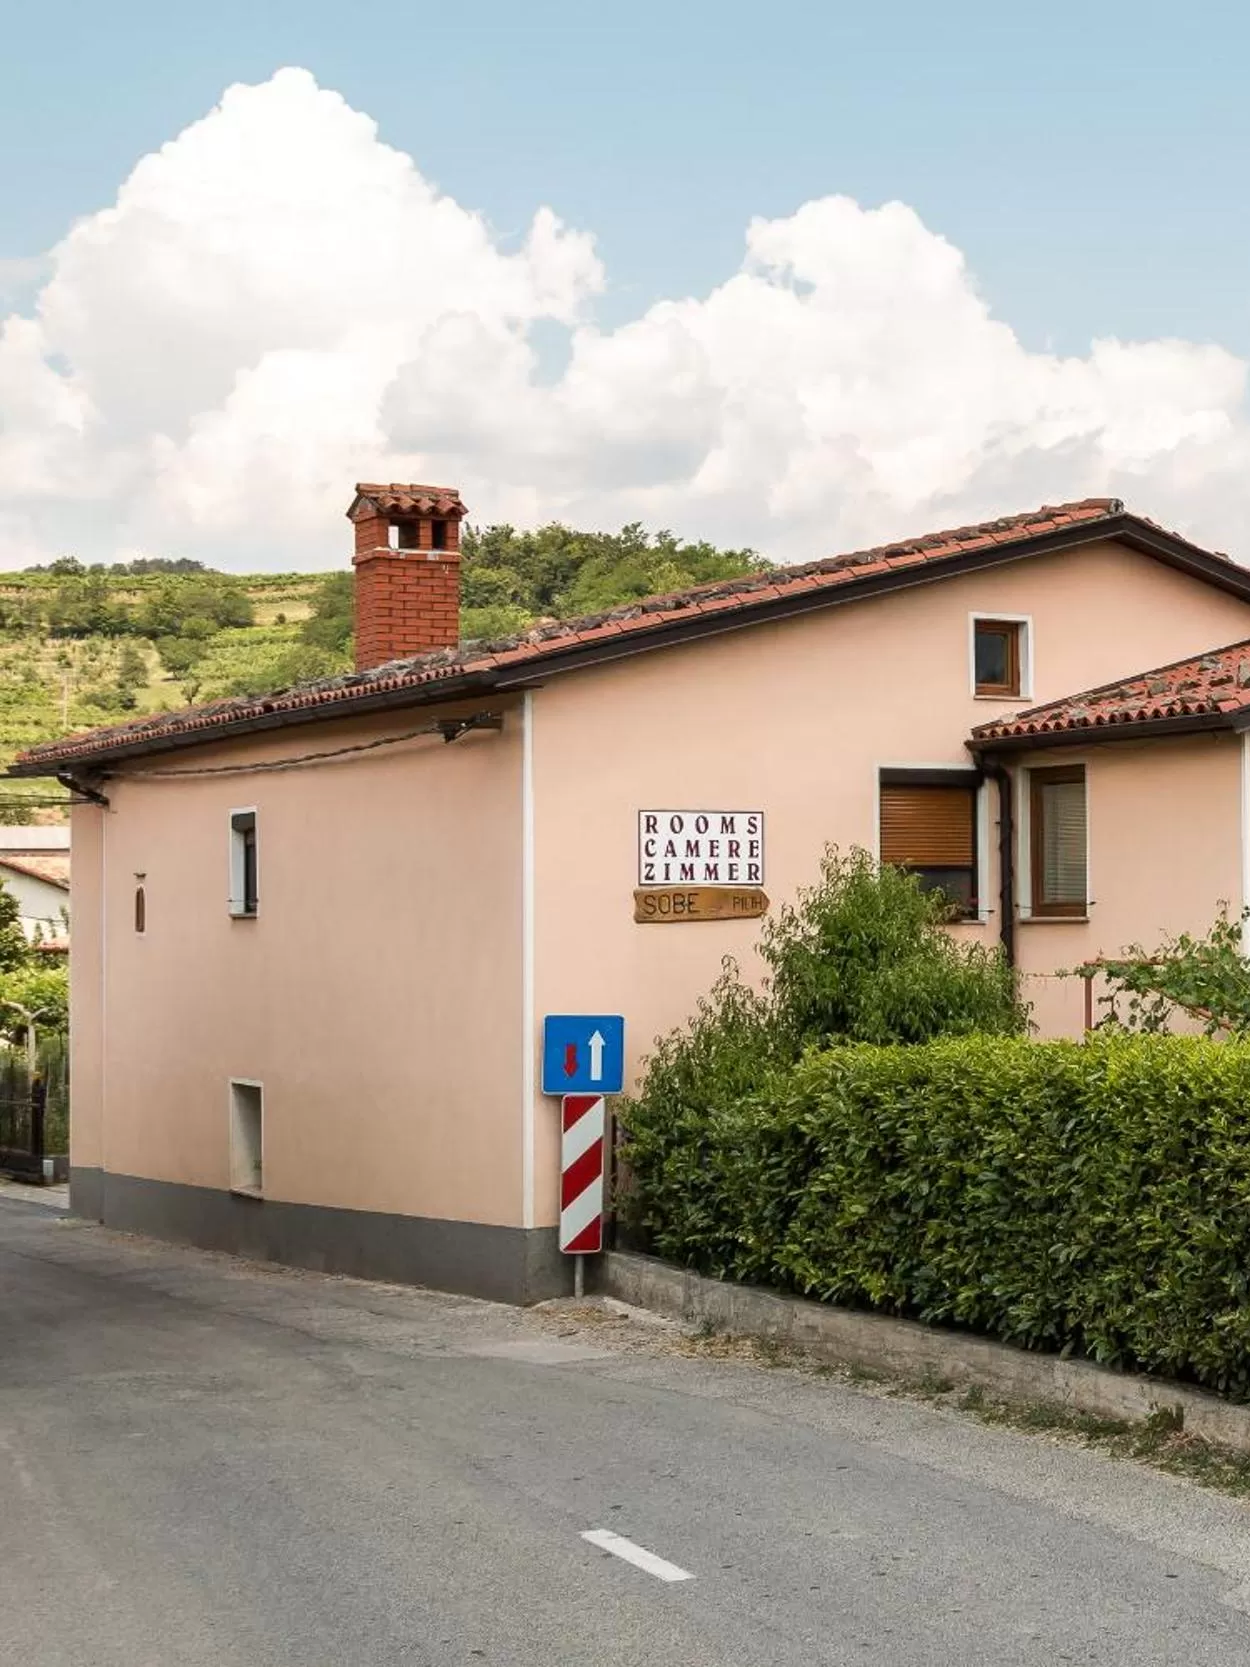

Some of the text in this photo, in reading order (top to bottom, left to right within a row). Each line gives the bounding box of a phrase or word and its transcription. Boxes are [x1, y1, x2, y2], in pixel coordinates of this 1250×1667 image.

[644, 815, 758, 834] ROOMS
[644, 839, 759, 858] CAMERE
[644, 863, 760, 881] ZIMMER
[643, 893, 700, 915] SOBE
